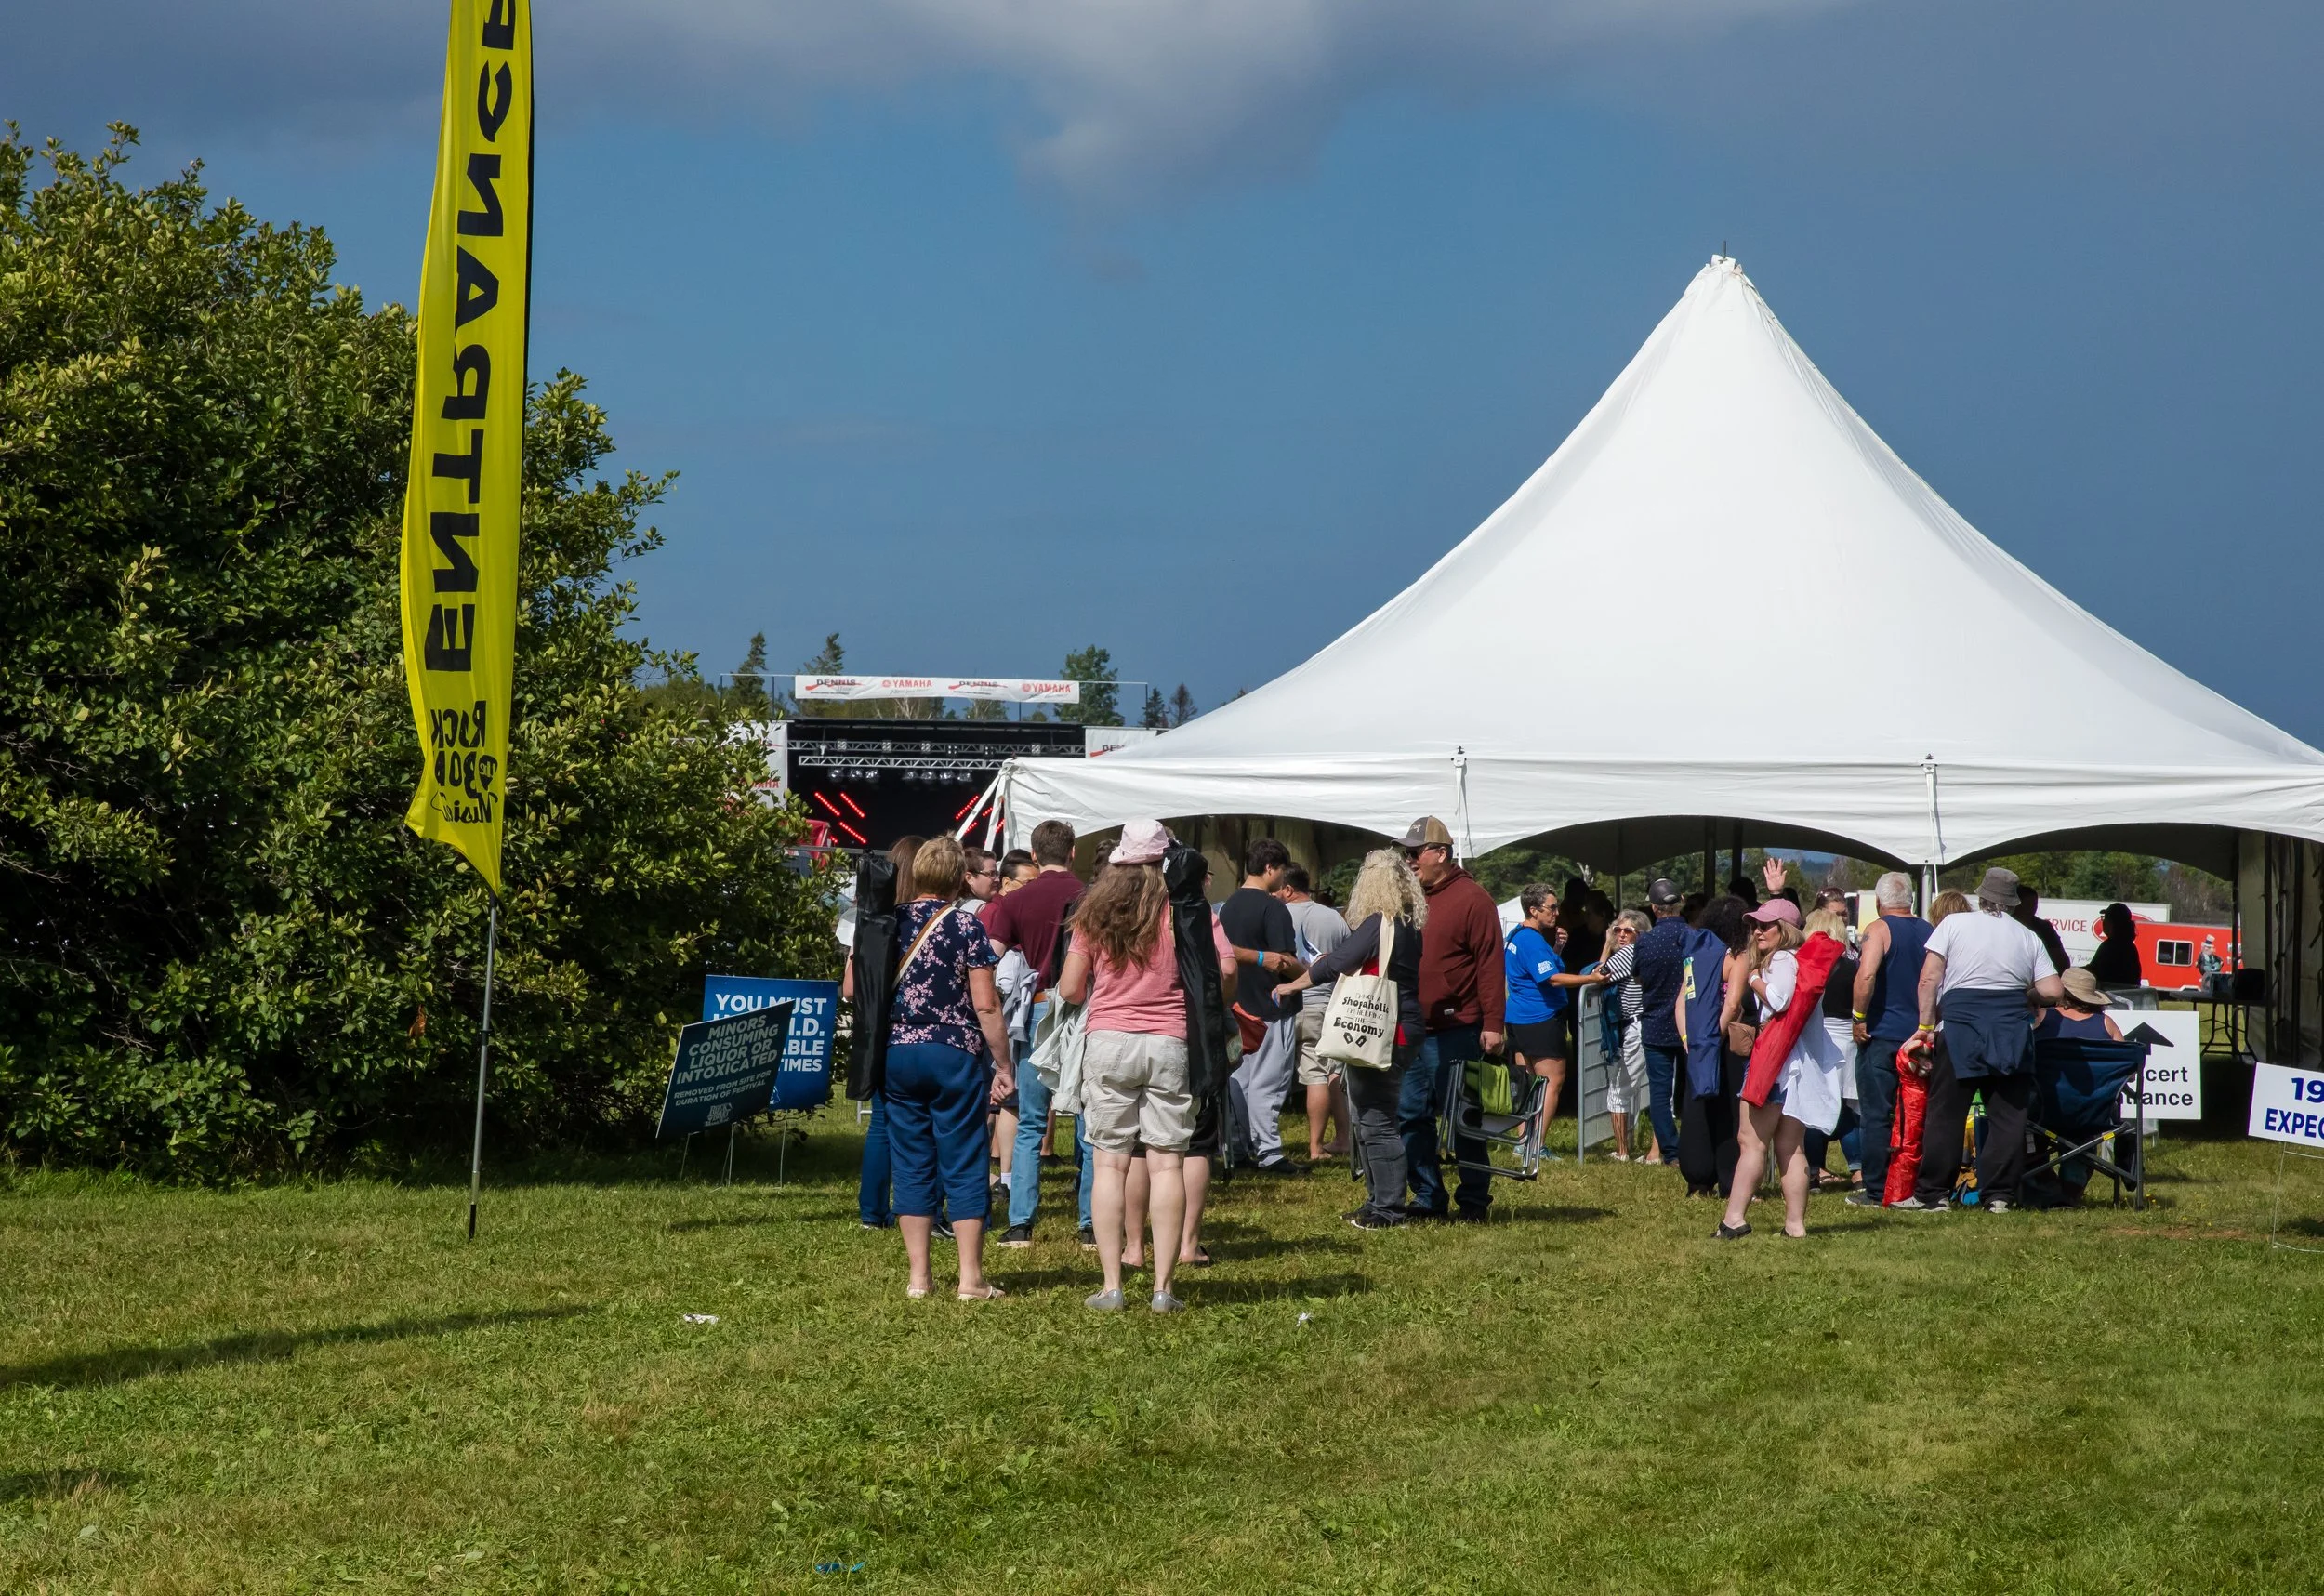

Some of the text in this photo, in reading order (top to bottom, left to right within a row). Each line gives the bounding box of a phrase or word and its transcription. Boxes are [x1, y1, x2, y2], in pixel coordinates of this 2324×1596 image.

[892, 679, 932, 688] YAMAHA
[1033, 683, 1072, 693] YAMAHA
[2048, 918, 2087, 932] RVICE
[715, 993, 762, 1012] YOU
[1341, 996, 1390, 1014] Shopaholic
[707, 1014, 767, 1040] MINORS
[788, 1017, 825, 1036] I.D.
[1333, 1016, 1384, 1038] Economy
[688, 1024, 779, 1056] CONSUMING
[689, 1038, 772, 1069] LIQUOR OR
[676, 1049, 778, 1085] INTOXICATED
[2127, 1066, 2188, 1083] cert
[674, 1070, 772, 1099] REMOVED FROM SITE FOR
[675, 1079, 766, 1106] DURATION OF FESTIVAL
